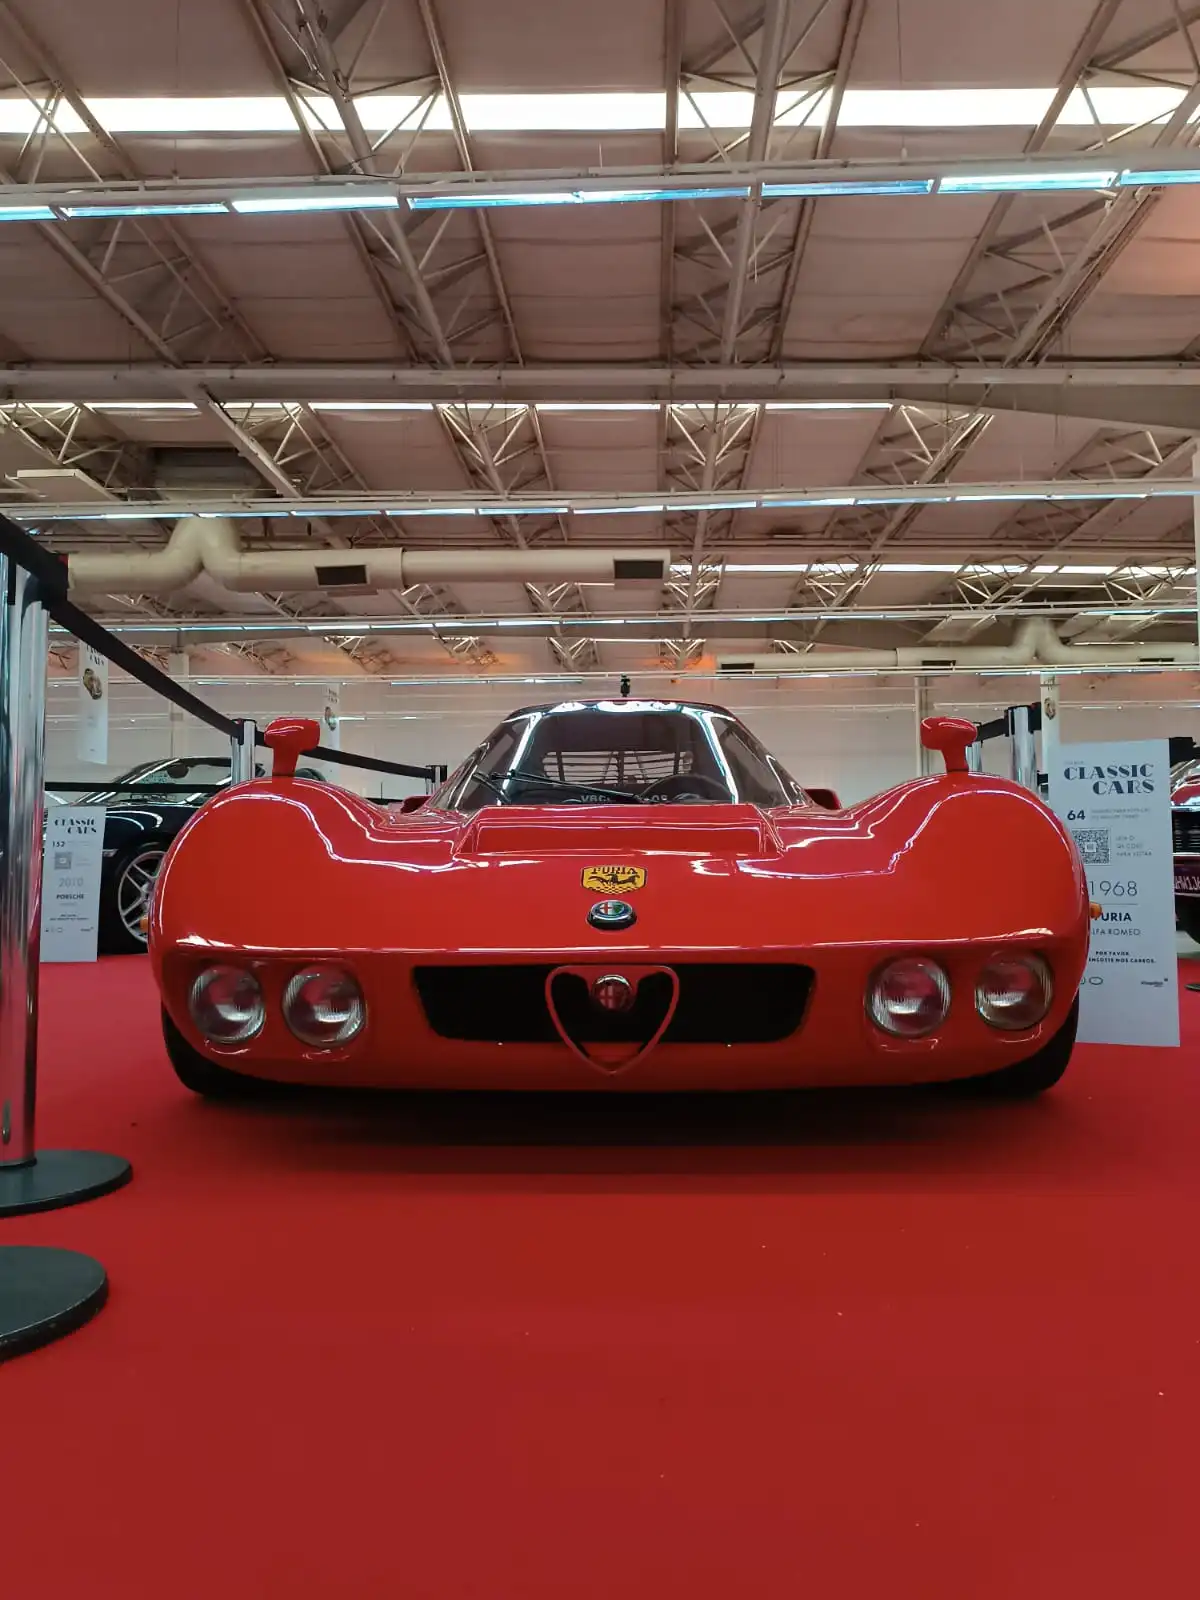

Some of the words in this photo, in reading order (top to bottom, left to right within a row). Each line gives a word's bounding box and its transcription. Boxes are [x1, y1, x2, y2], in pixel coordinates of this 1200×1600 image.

[1064, 763, 1154, 781] CLASSIC
[1092, 779, 1155, 796] CARS
[1067, 809, 1086, 821] 64
[591, 866, 638, 875] FURIA
[58, 877, 84, 888] 2010
[1089, 880, 1138, 897] 1968
[1094, 912, 1132, 922] URIA
[1108, 928, 1141, 936] ROMEO
